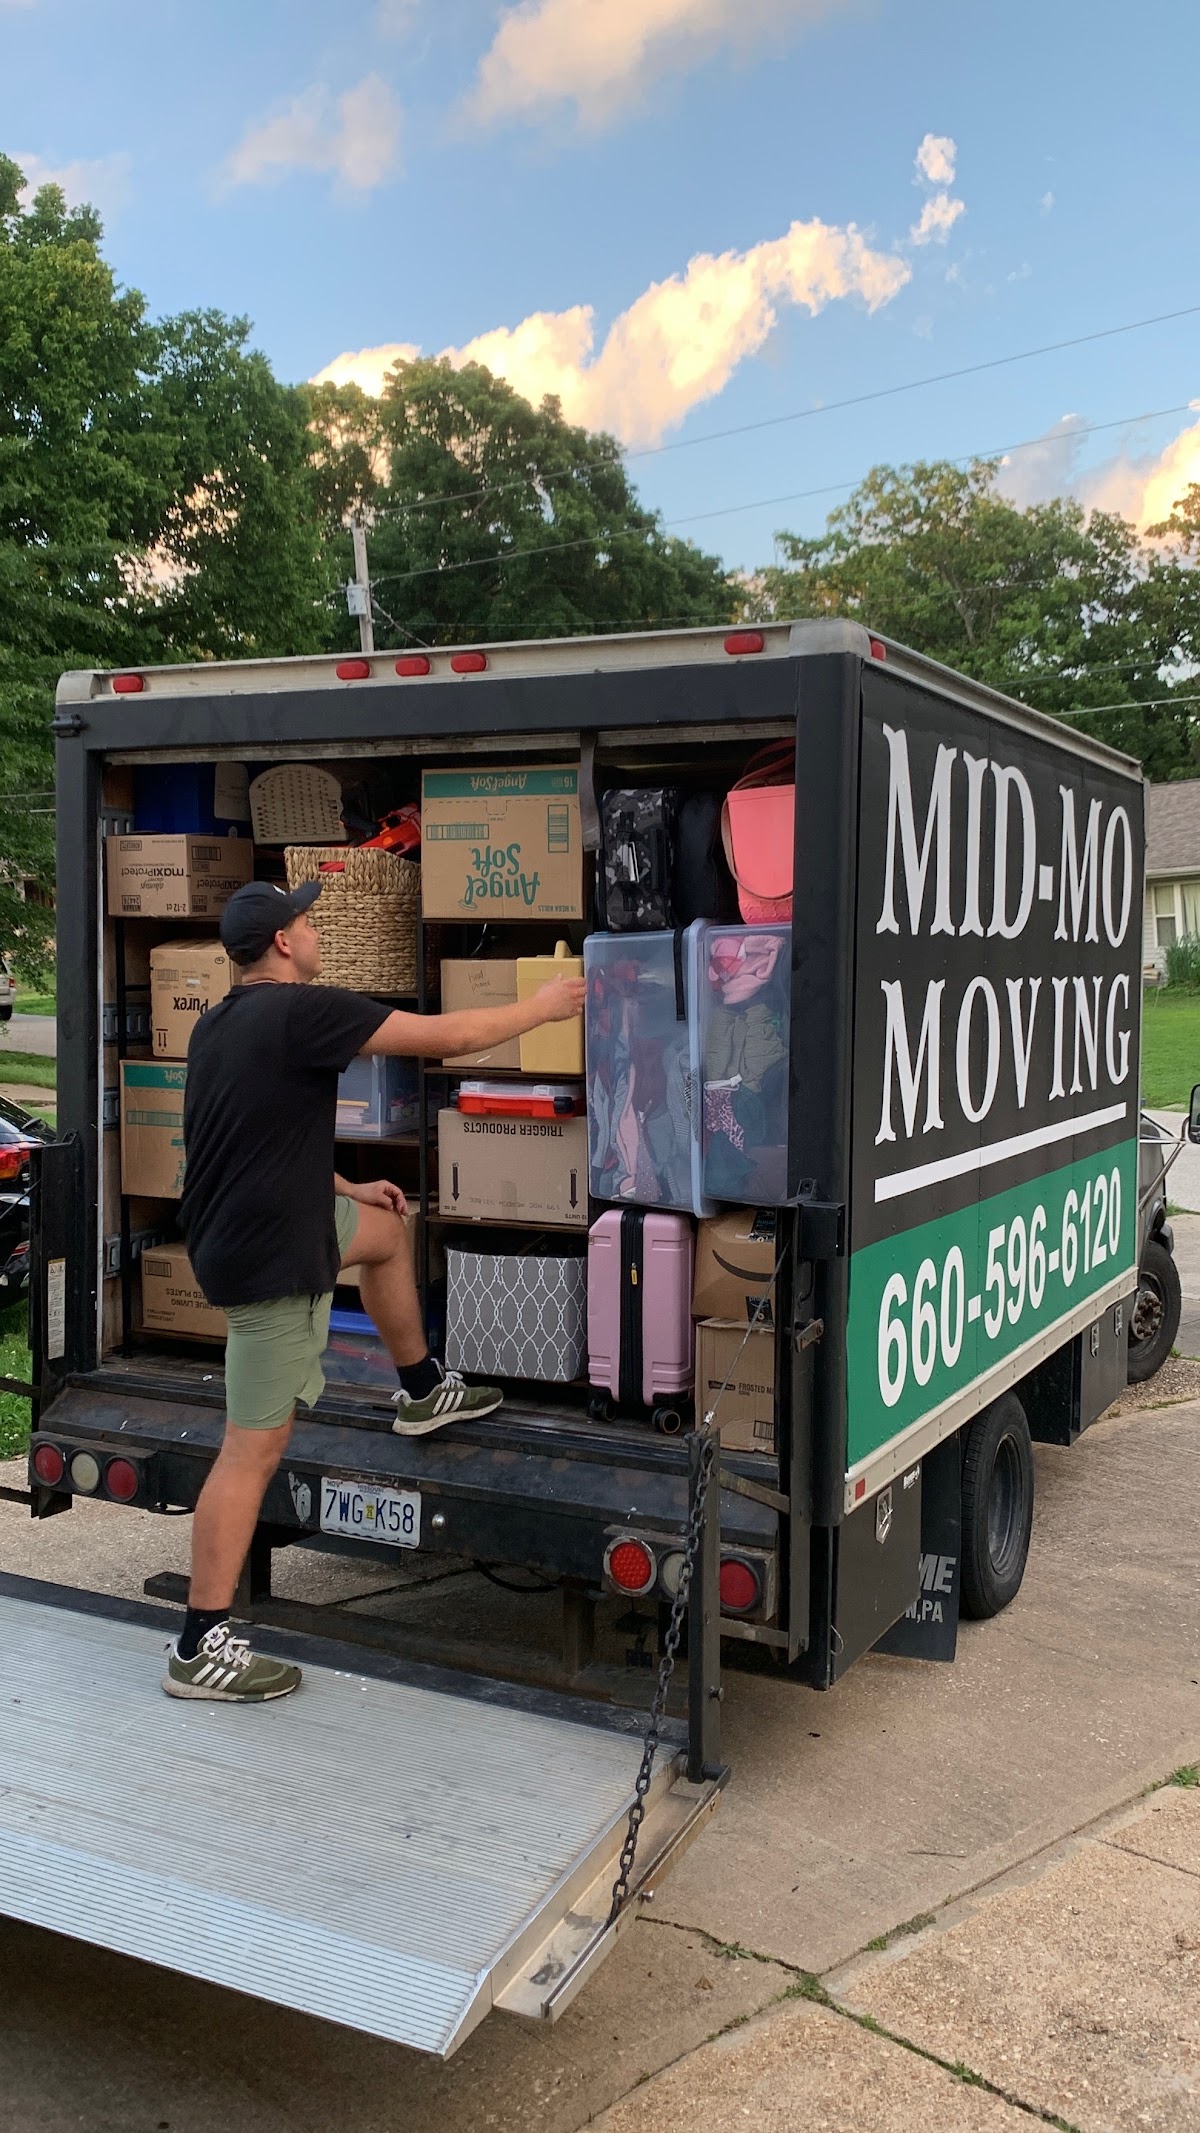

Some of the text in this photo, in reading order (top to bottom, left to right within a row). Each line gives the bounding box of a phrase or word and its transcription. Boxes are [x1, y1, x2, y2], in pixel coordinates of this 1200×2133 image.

[876, 723, 1133, 948] MID-MO
[471, 843, 521, 877] Soft
[121, 867, 184, 877] maxiProtect
[464, 871, 540, 905] Angel
[166, 903, 173, 912] ct
[173, 903, 187, 912] 2-12
[173, 997, 208, 1015] Purex
[874, 974, 1130, 1145] MOVING
[463, 1122, 563, 1137] TRIGGER PRODUCTS
[165, 1287, 191, 1298] PLATES
[877, 1166, 1122, 1407] 660-596-6120
[171, 1298, 194, 1308] LIVING
[738, 1382, 766, 1394] FROSTED
[325, 1488, 414, 1534] 7WG K58
[919, 1553, 957, 1594] ME
